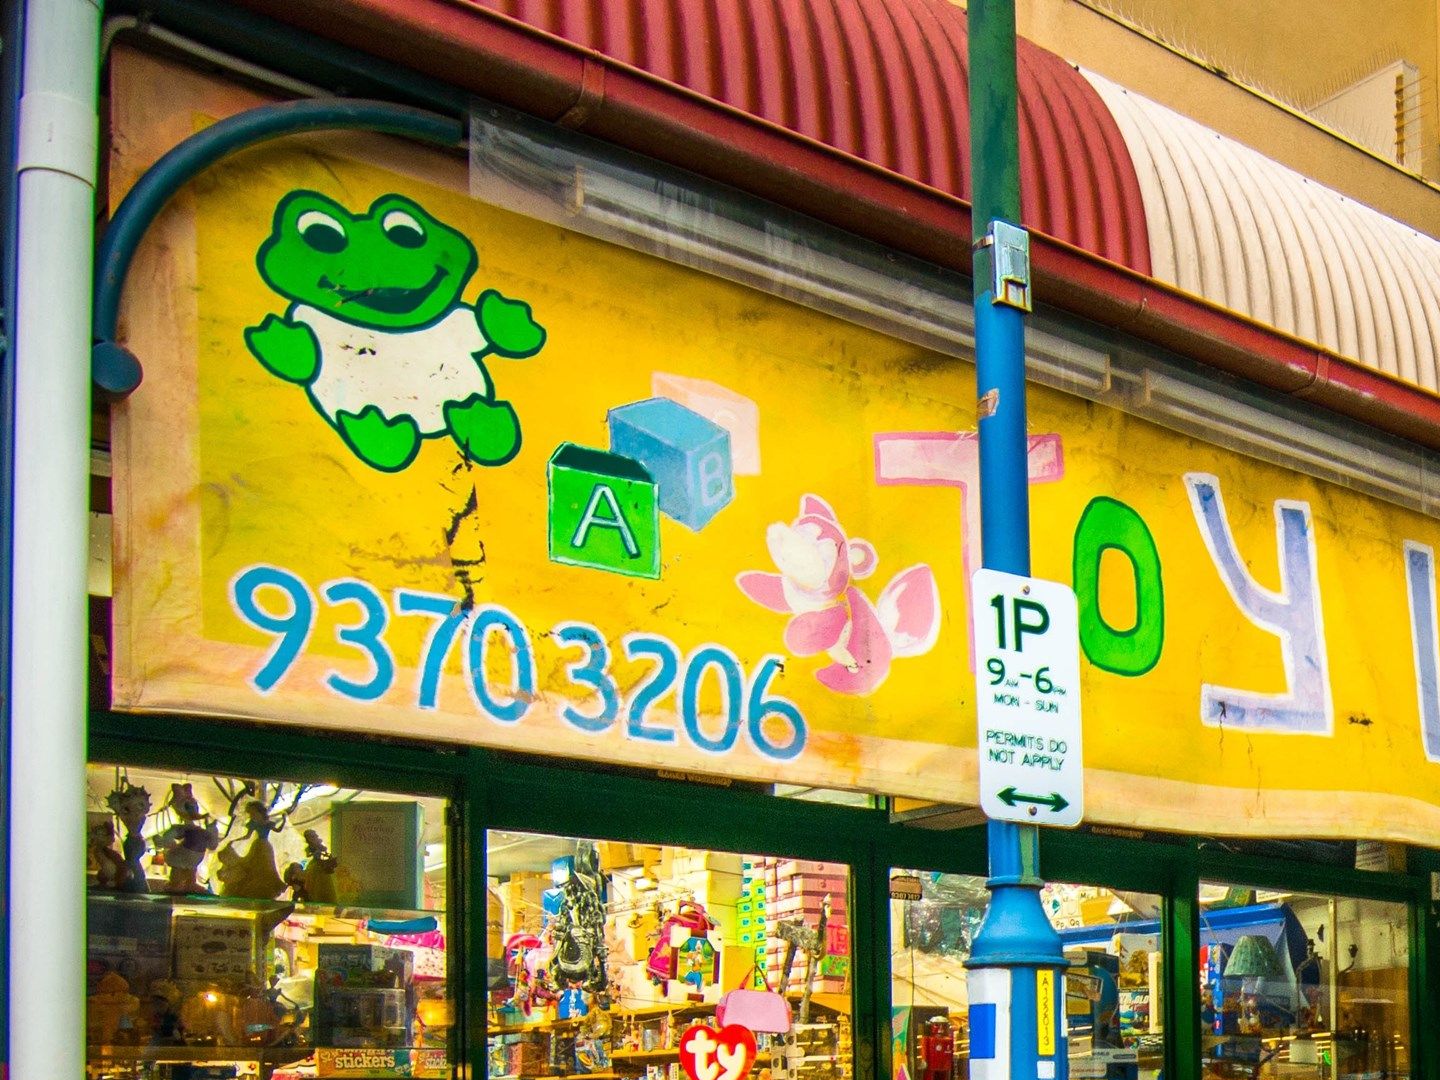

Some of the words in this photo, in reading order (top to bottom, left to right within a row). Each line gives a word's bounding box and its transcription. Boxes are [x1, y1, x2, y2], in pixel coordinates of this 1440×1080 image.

[990, 594, 1050, 652] 1P
[231, 564, 534, 723] 9370
[551, 622, 808, 761] 3206
[993, 693, 1020, 708] MON
[1035, 699, 1059, 714] SUN
[986, 730, 1043, 750] PERMITS
[1050, 738, 1067, 753] DO
[988, 748, 1014, 764] NOT
[1021, 752, 1064, 771] APPLY
[335, 1053, 395, 1069] stickers
